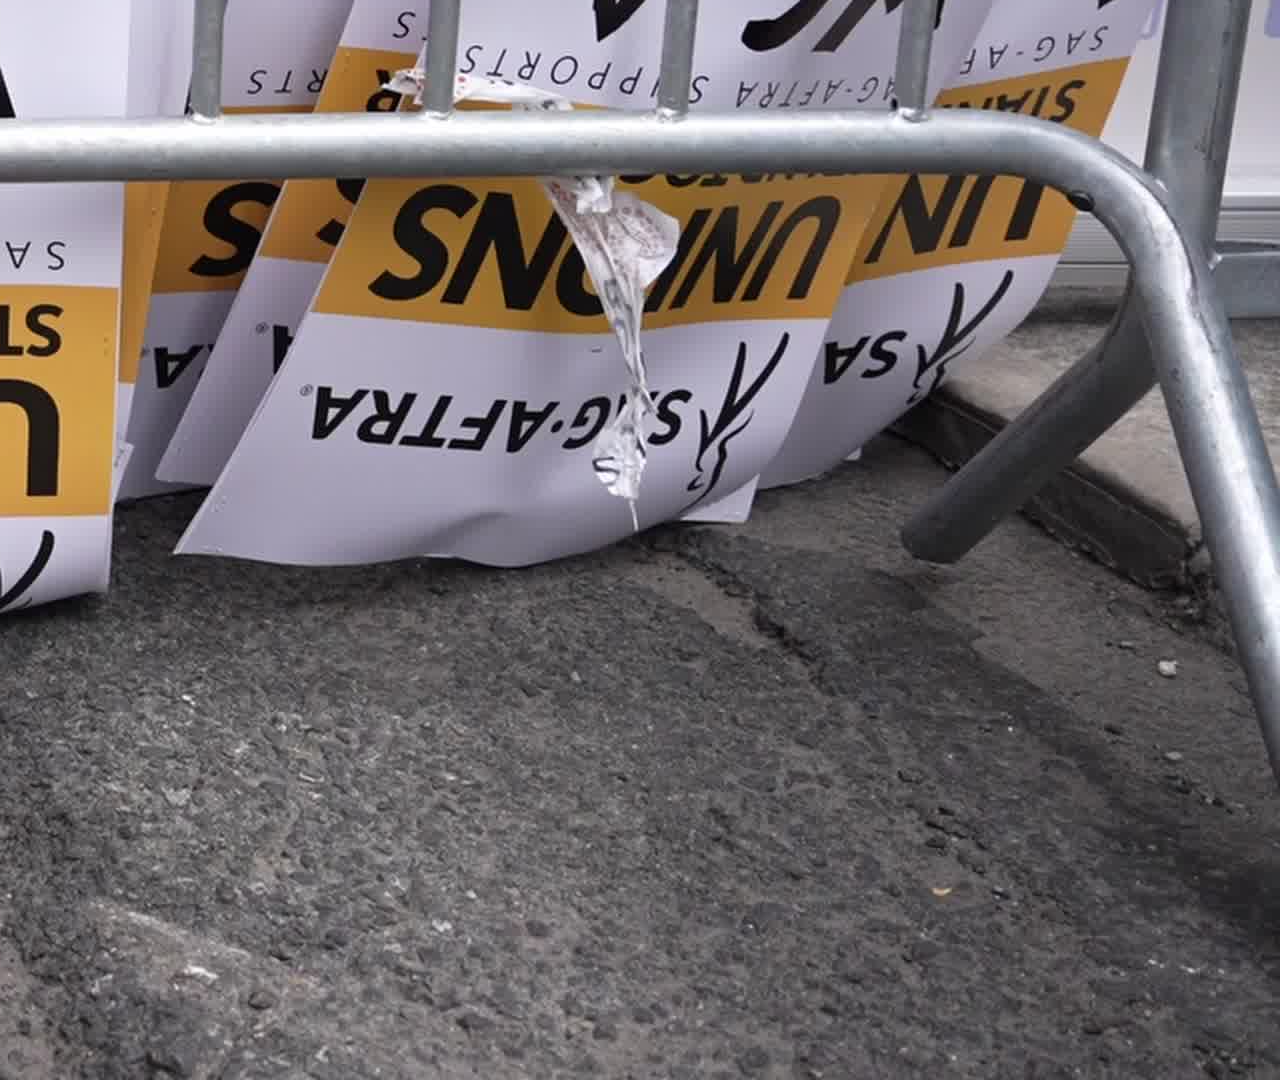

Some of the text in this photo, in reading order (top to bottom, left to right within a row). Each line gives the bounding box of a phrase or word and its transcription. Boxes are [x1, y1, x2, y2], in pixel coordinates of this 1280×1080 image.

[460, 44, 897, 110] AG-AFTRA SPPORTS
[962, 27, 1108, 73] SAG-AF
